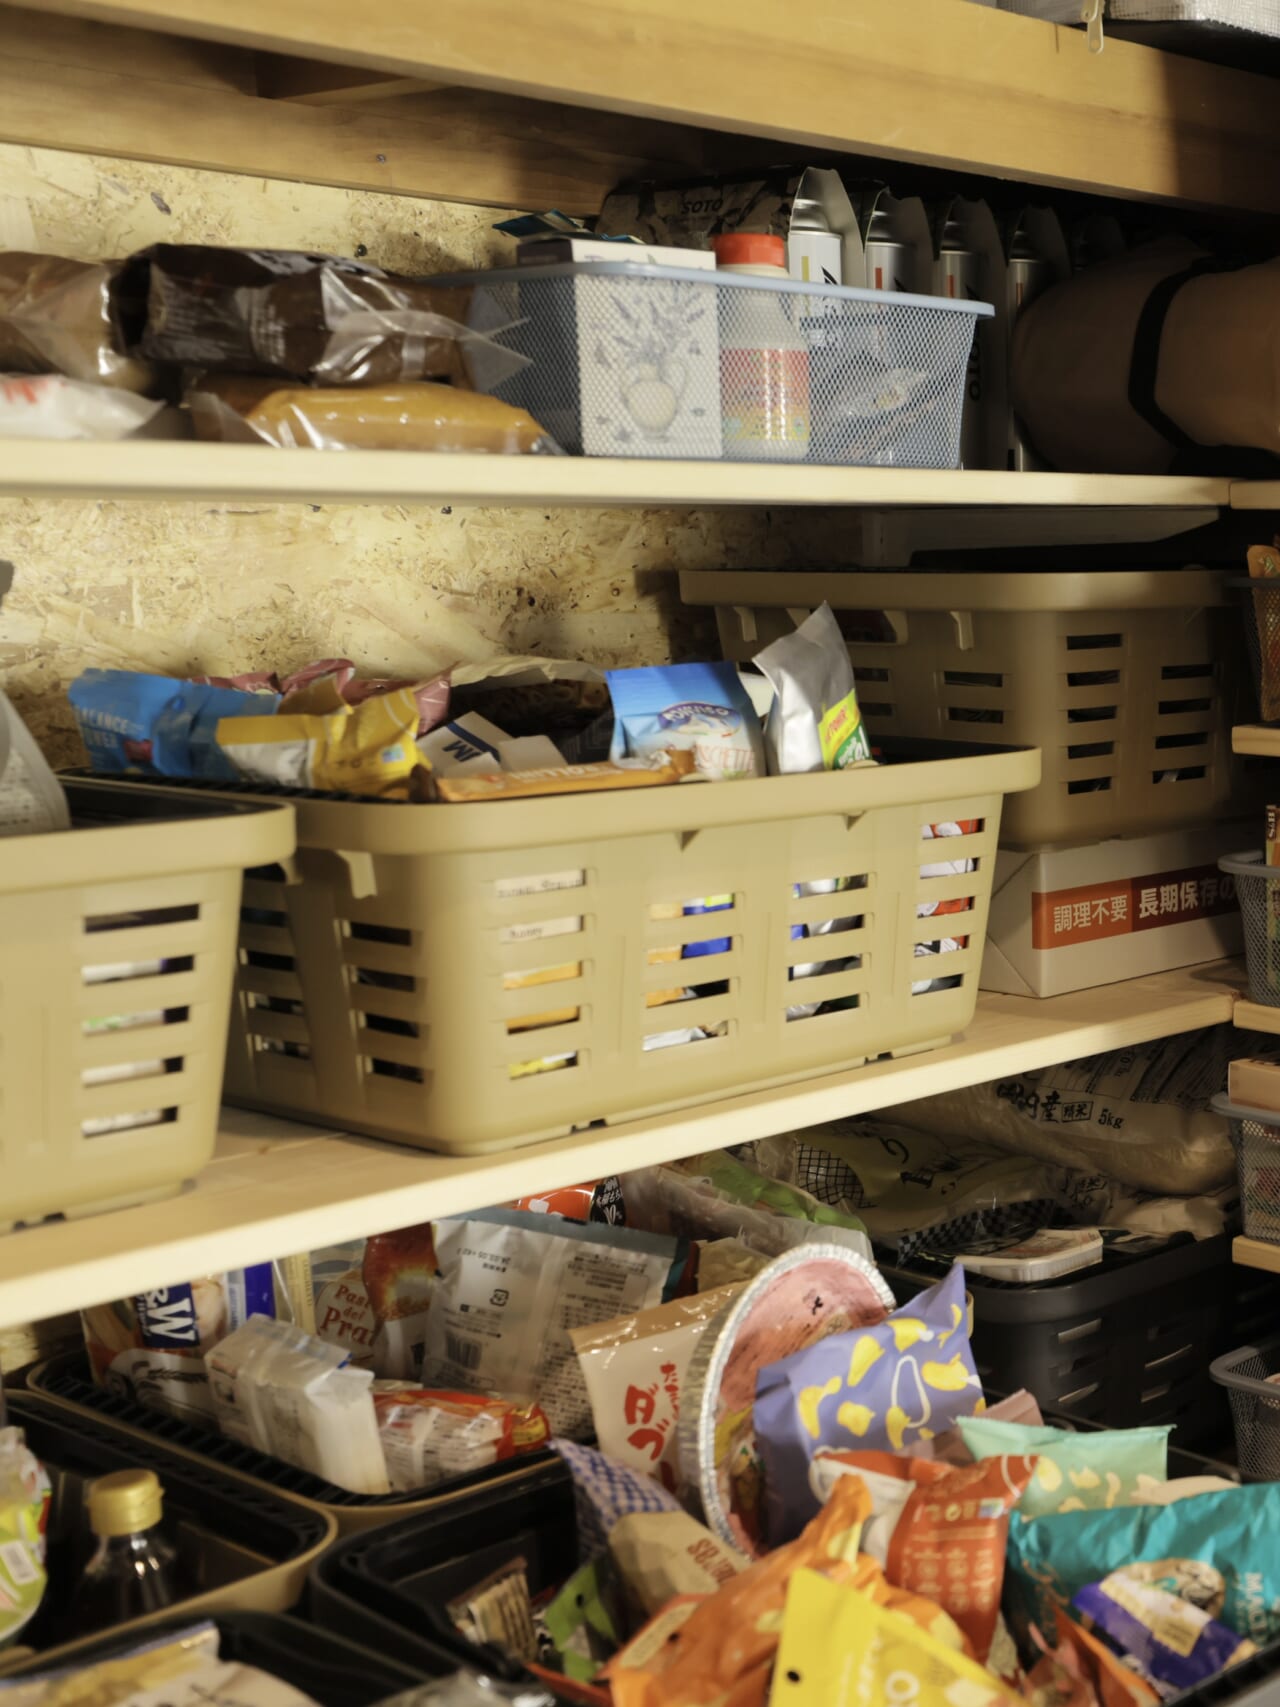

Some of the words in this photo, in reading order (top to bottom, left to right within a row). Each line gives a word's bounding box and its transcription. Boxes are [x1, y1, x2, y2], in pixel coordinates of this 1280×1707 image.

[1054, 895, 1128, 934] 調理不要
[1098, 1107, 1124, 1130] 5kg
[343, 1306, 366, 1321] del
